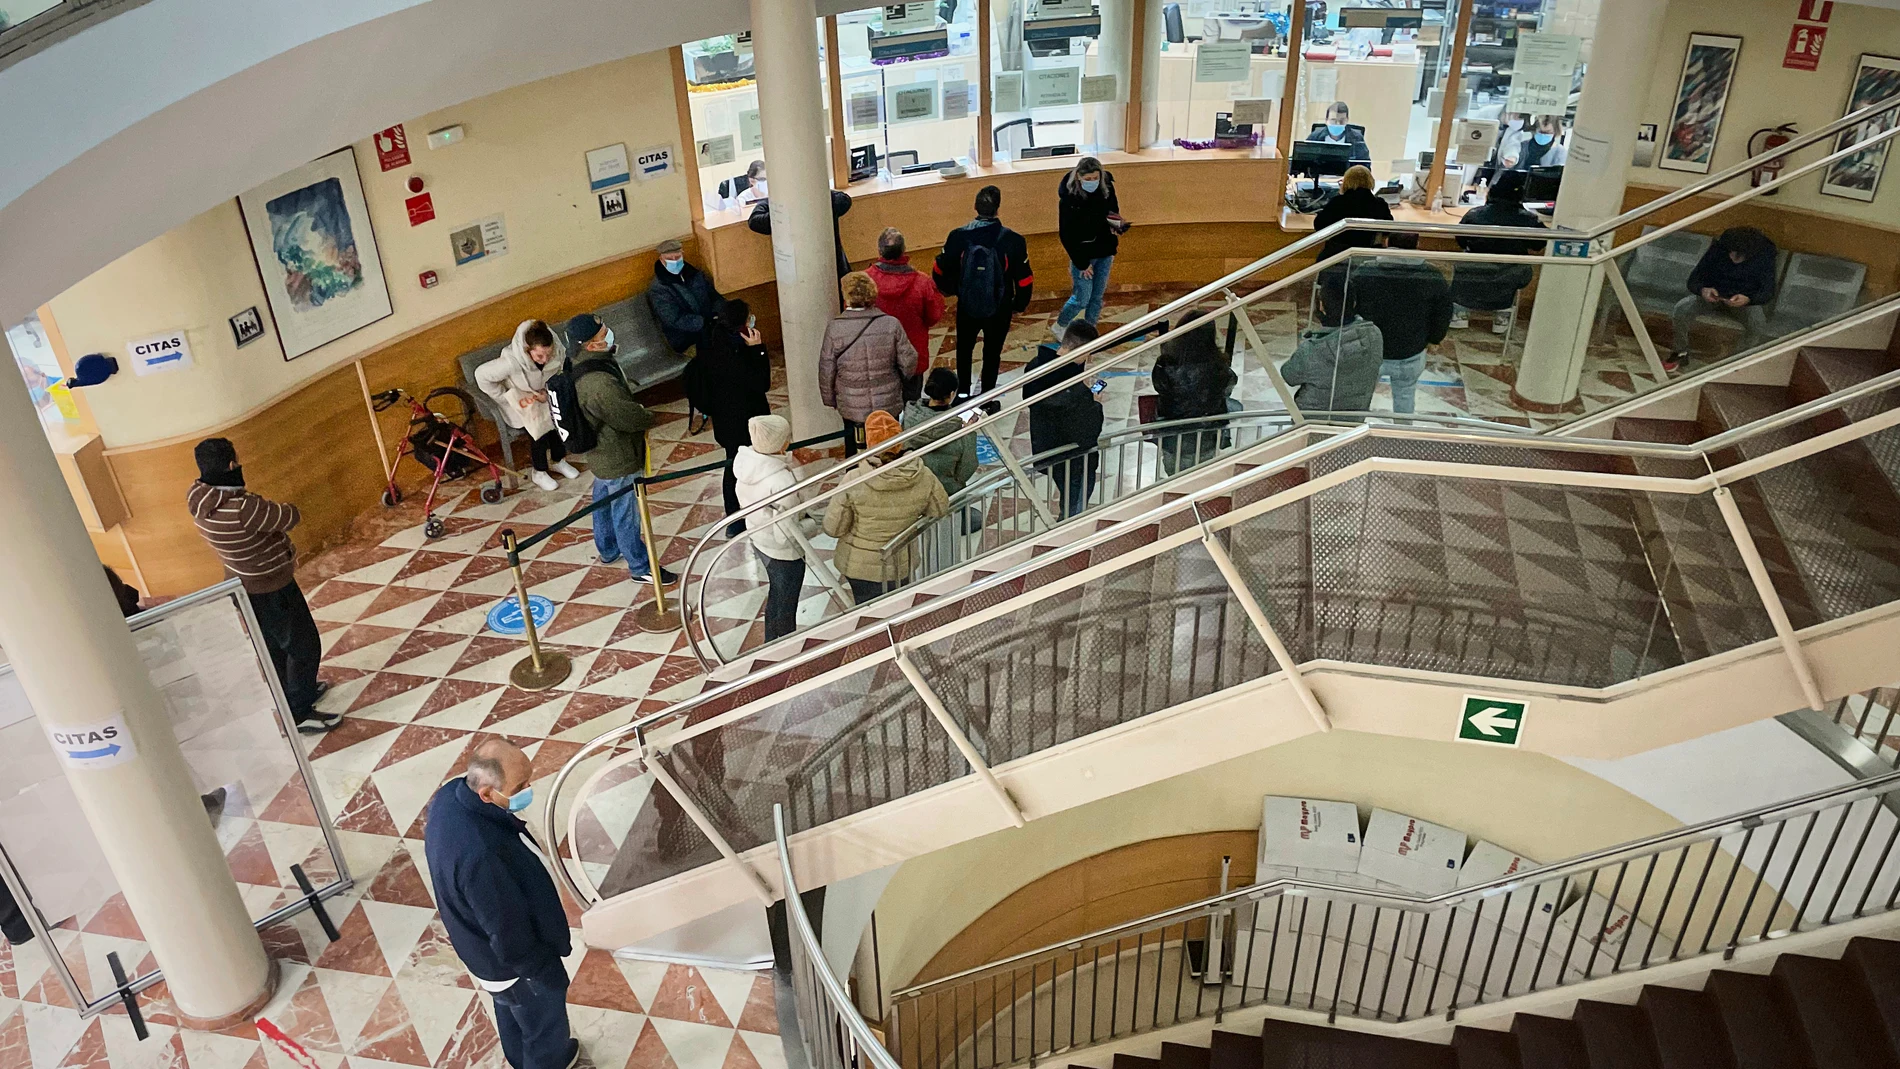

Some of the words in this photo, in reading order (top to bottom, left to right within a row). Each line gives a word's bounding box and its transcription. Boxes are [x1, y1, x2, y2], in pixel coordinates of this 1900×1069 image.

[1524, 81, 1557, 92] Tarjeta
[638, 151, 668, 165] CITAS
[135, 337, 181, 355] CITAS
[53, 726, 118, 745] CITAS
[1503, 856, 1521, 876] aypro
